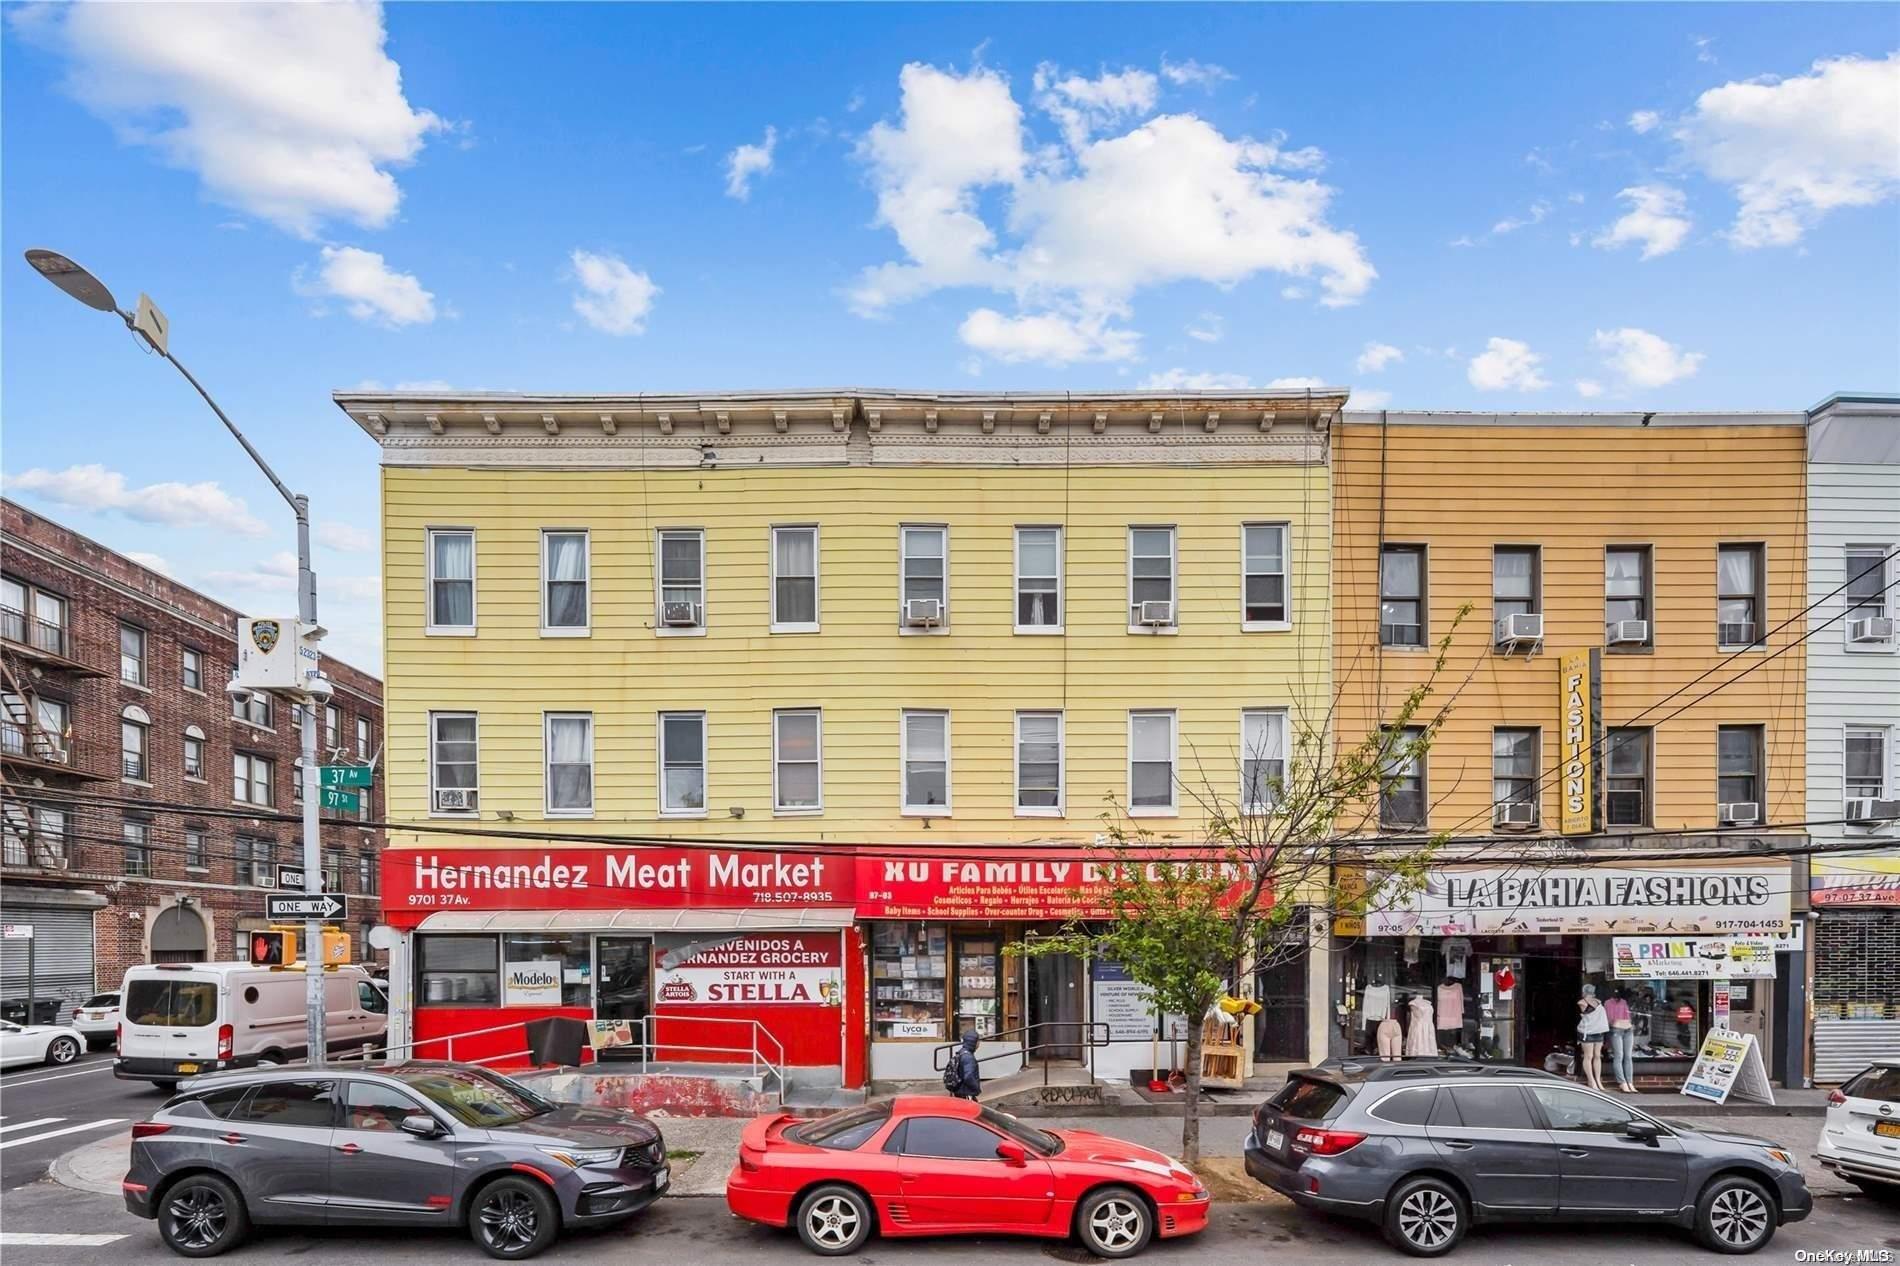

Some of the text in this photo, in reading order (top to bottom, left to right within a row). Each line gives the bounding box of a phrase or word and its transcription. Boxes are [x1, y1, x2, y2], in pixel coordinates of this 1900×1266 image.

[1566, 673, 1585, 814] FASHIONS
[332, 769, 345, 783] 37
[328, 792, 339, 805] 97
[415, 854, 825, 889] Hernandez Meat Market
[885, 862, 929, 882] XU
[942, 863, 1070, 883] FAMILY
[285, 873, 301, 884] ONE
[1448, 876, 1769, 907] LA BAHIA FASHIONS
[408, 894, 436, 905] 9701
[753, 892, 833, 903] 718.507-8935
[1859, 893, 1872, 902] 37
[1876, 893, 1898, 902] Ave.
[279, 902, 334, 911] ONE WAY
[885, 906, 901, 916] Baby
[902, 906, 921, 915] Items
[927, 907, 949, 915] School
[951, 907, 978, 917] Supplies
[1378, 924, 1403, 932] 97-05
[1715, 920, 1784, 929] 917-704-1453
[705, 940, 804, 950] NVENIDOS A
[1638, 941, 1697, 959] PRINT
[679, 952, 829, 964] RNANDEZ GROCERY
[513, 972, 553, 985] Modelo
[724, 971, 796, 980] START WITH A
[708, 983, 811, 1001] STELLA
[902, 1025, 921, 1034] Lyca
